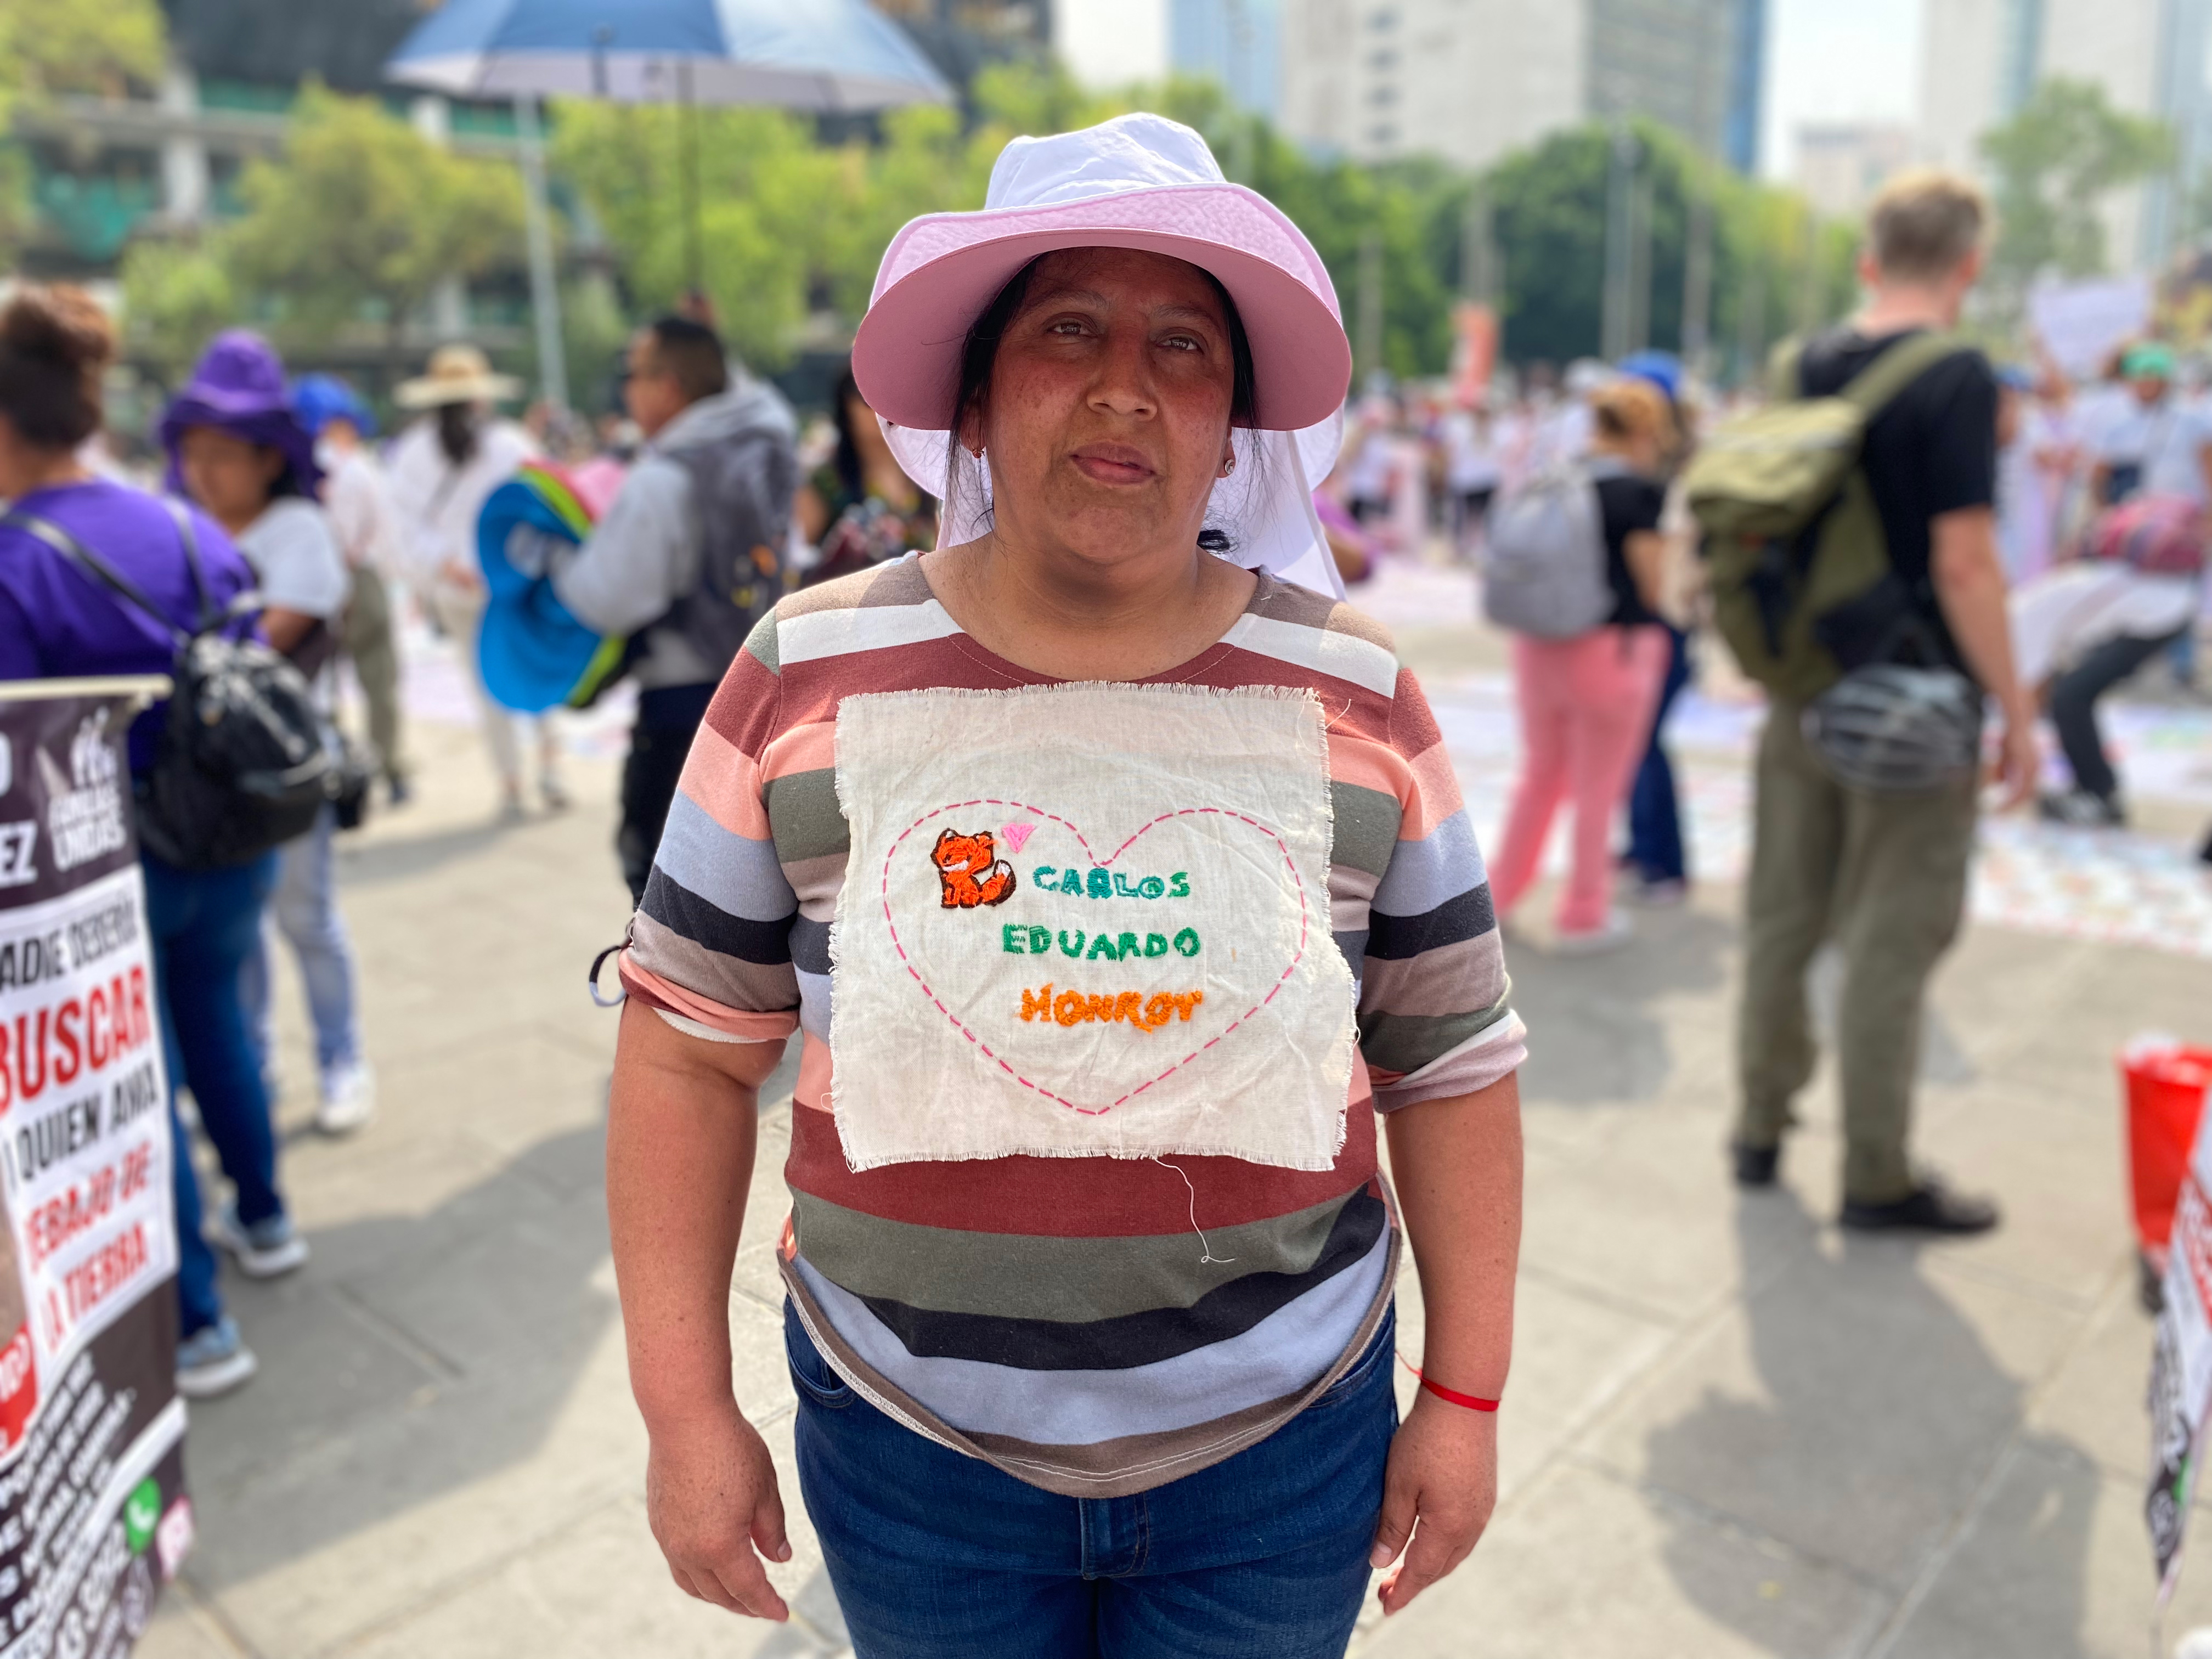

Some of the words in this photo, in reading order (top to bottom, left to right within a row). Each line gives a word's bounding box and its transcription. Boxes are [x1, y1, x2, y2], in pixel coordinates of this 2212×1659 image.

[1032, 865, 1191, 900] CARLOS
[1002, 923, 1201, 962] EDUARDO
[1018, 983, 1203, 1034] MONROY
[25, 1165, 116, 1274] EBAJO
